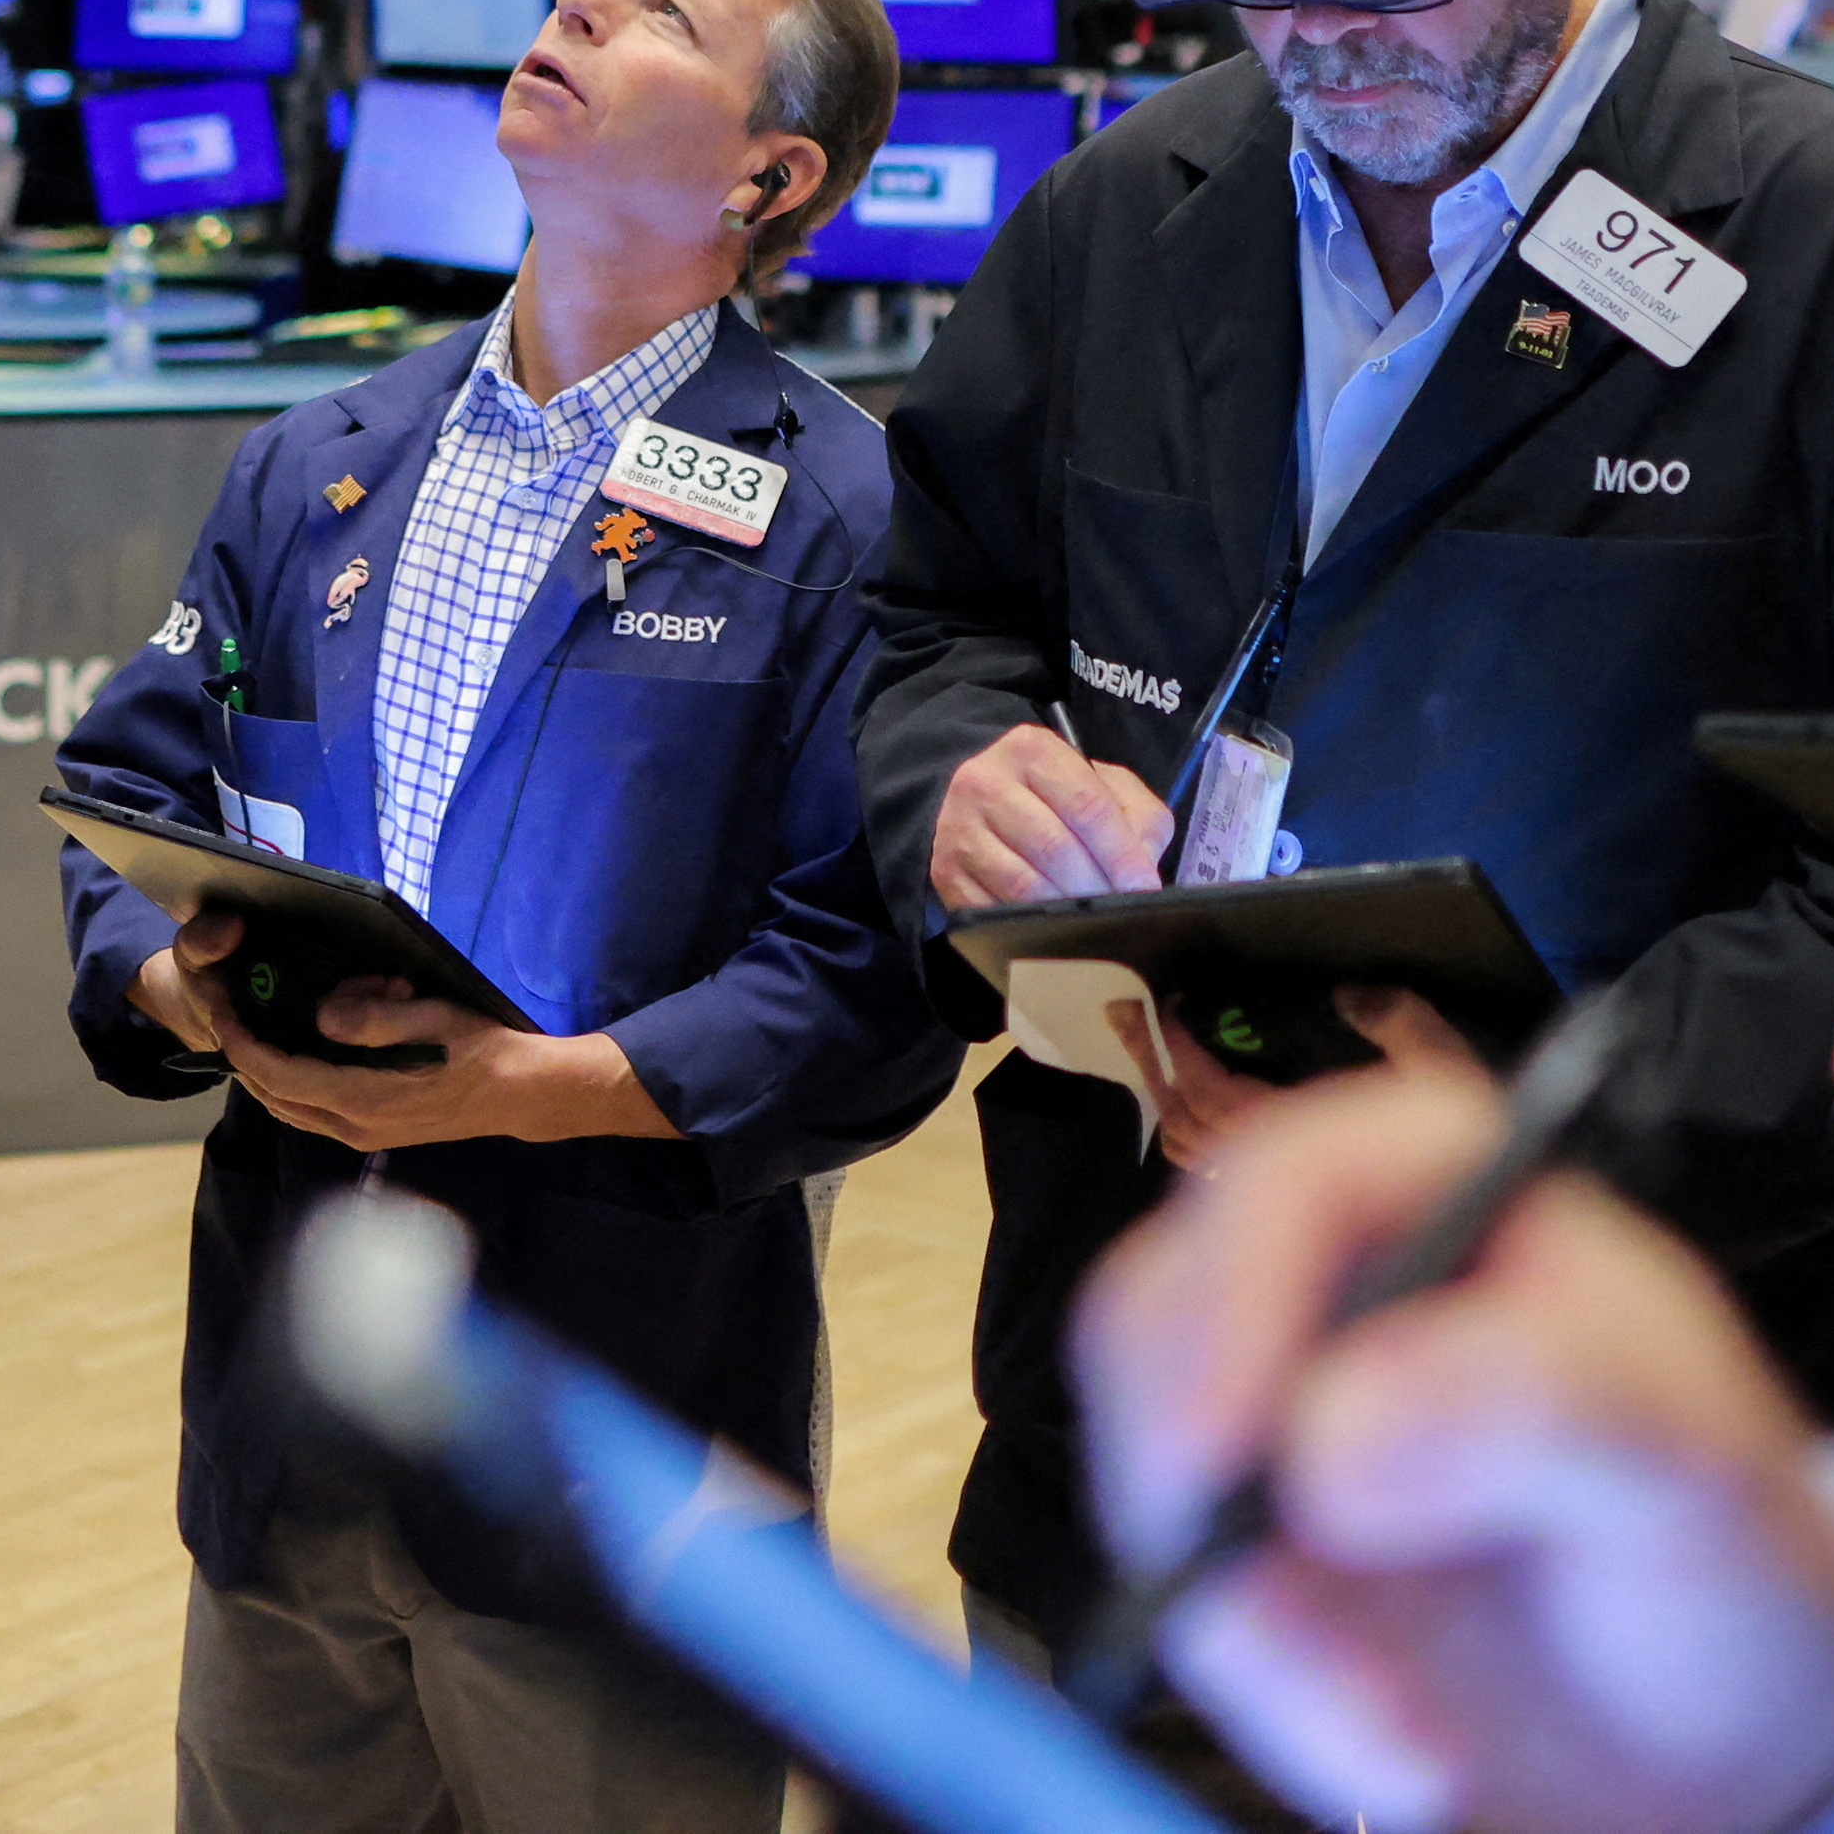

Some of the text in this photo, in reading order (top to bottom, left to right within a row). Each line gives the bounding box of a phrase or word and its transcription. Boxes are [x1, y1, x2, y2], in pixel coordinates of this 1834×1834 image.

[1558, 237, 1604, 270] JAMES
[1596, 210, 1697, 296] 971
[636, 434, 764, 503] 3333
[1594, 457, 1691, 494] MOO
[686, 490, 741, 517] CHARMAK
[745, 510, 758, 522] IV
[612, 610, 728, 644] BOBBY
